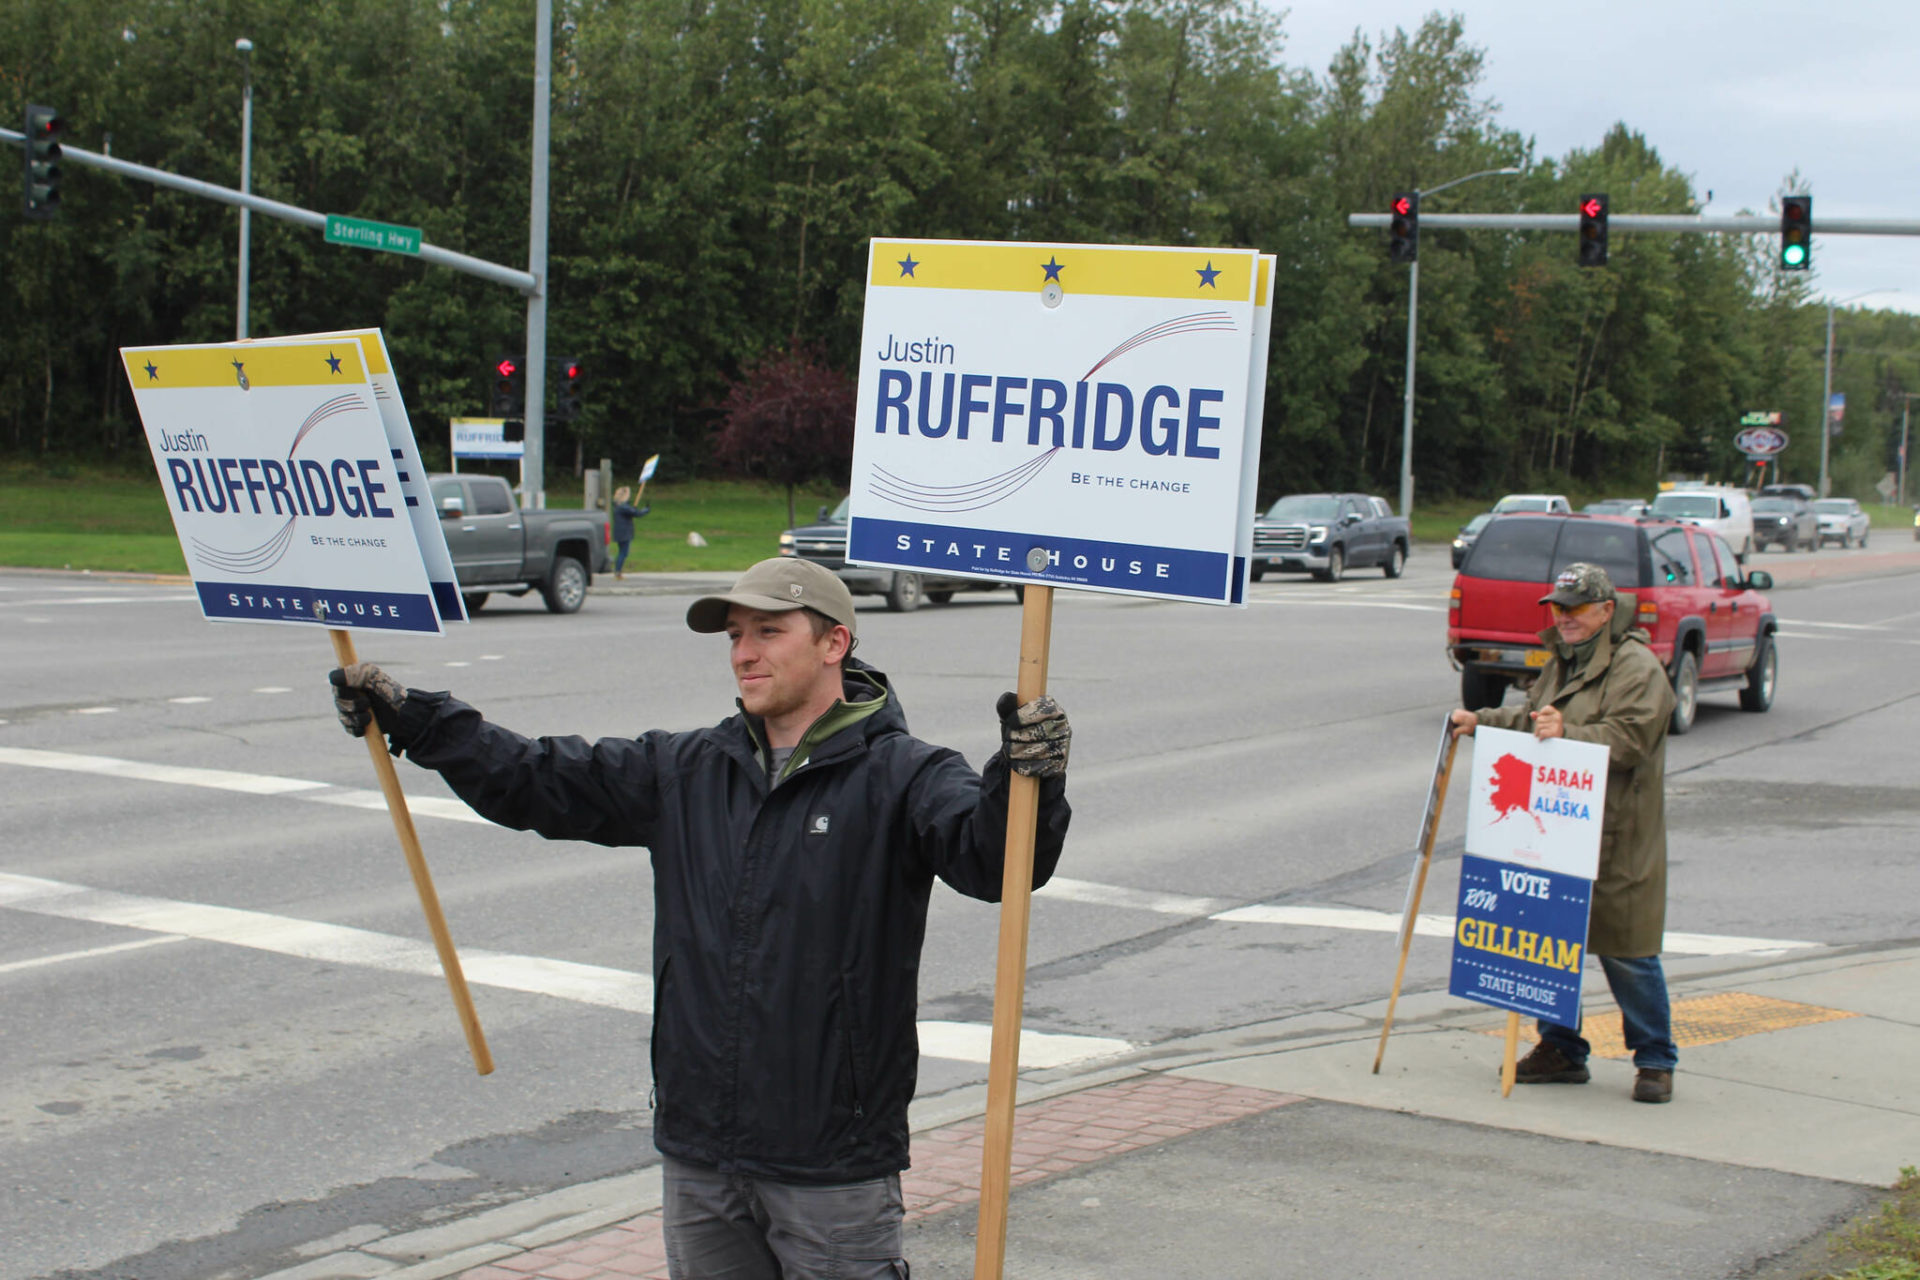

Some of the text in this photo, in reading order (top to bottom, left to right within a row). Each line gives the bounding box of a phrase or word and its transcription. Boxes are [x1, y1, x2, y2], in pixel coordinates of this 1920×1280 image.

[333, 222, 413, 250] Sterling Hwy
[878, 334, 954, 365] Justin
[875, 368, 1224, 460] RUFFRIDGE
[160, 428, 209, 452] Justin
[167, 458, 395, 519] RUFFRIDGE
[896, 534, 1011, 562] STATE
[1045, 549, 1170, 578] HOUSE
[228, 593, 400, 618] STATE HOUSE
[1536, 765, 1594, 791] SARAH
[1534, 796, 1590, 821] ALASKA
[1500, 869, 1551, 900] VOTE
[1457, 917, 1582, 974] GILLHAM
[1478, 973, 1516, 995] STATE
[1516, 982, 1557, 1006] HOUSE
